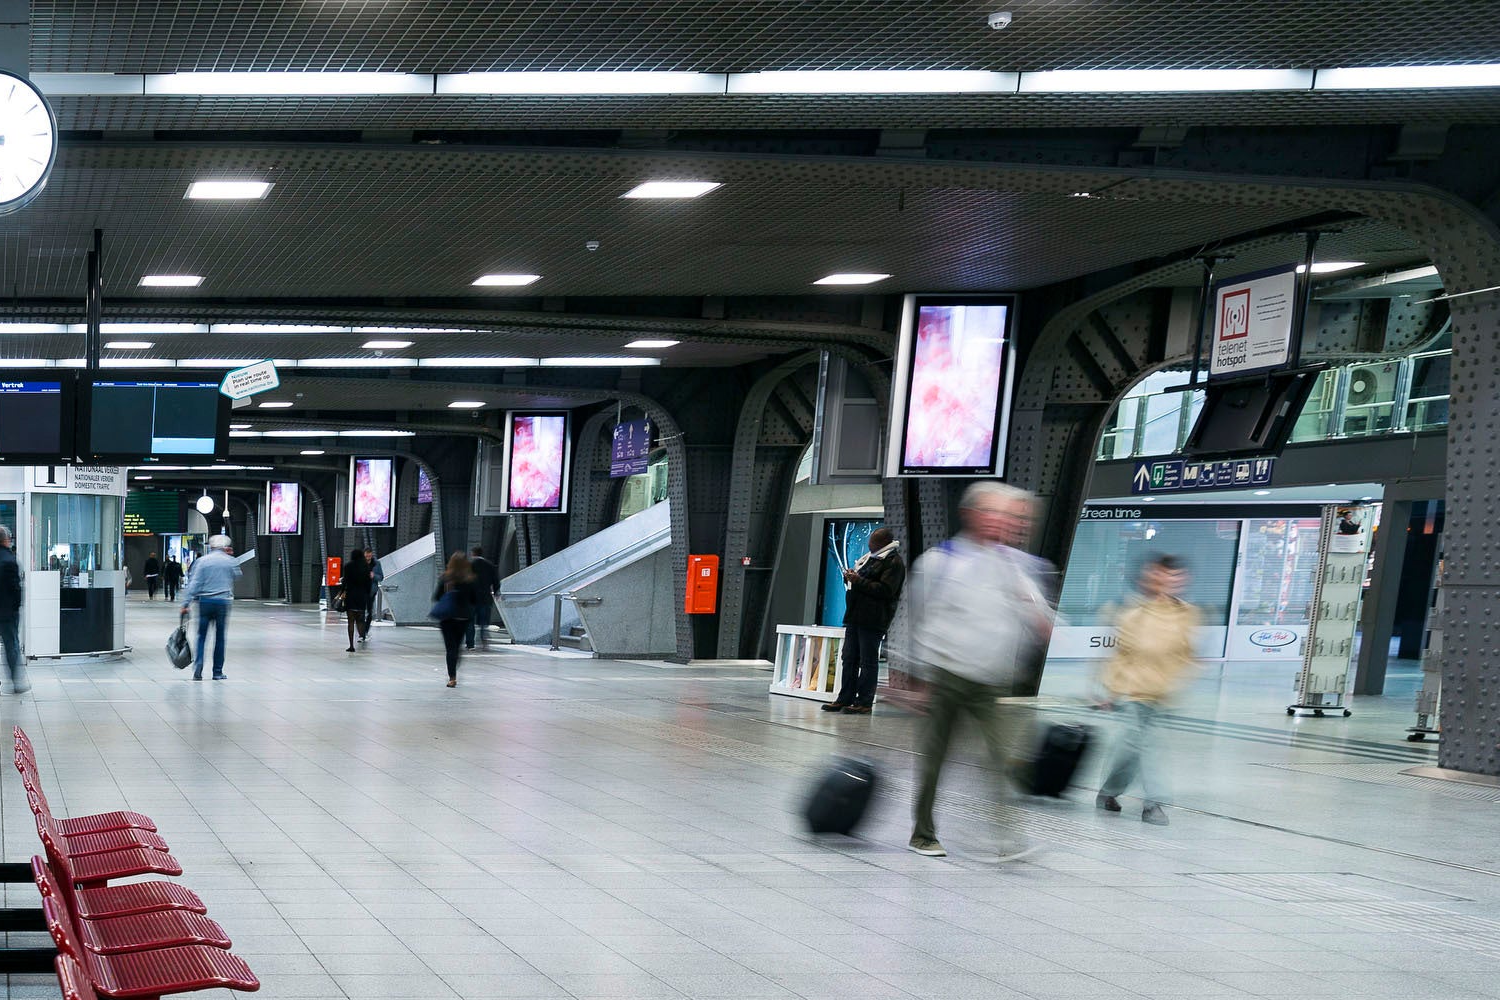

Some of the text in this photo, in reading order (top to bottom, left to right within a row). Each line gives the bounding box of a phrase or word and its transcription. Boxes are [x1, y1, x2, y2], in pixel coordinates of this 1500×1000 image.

[1219, 340, 1247, 356] telenet
[1216, 354, 1247, 368] hotspot
[1183, 466, 1199, 481] M
[74, 482, 111, 491] DOMESTIC TRAFFIC
[1114, 508, 1141, 519] time
